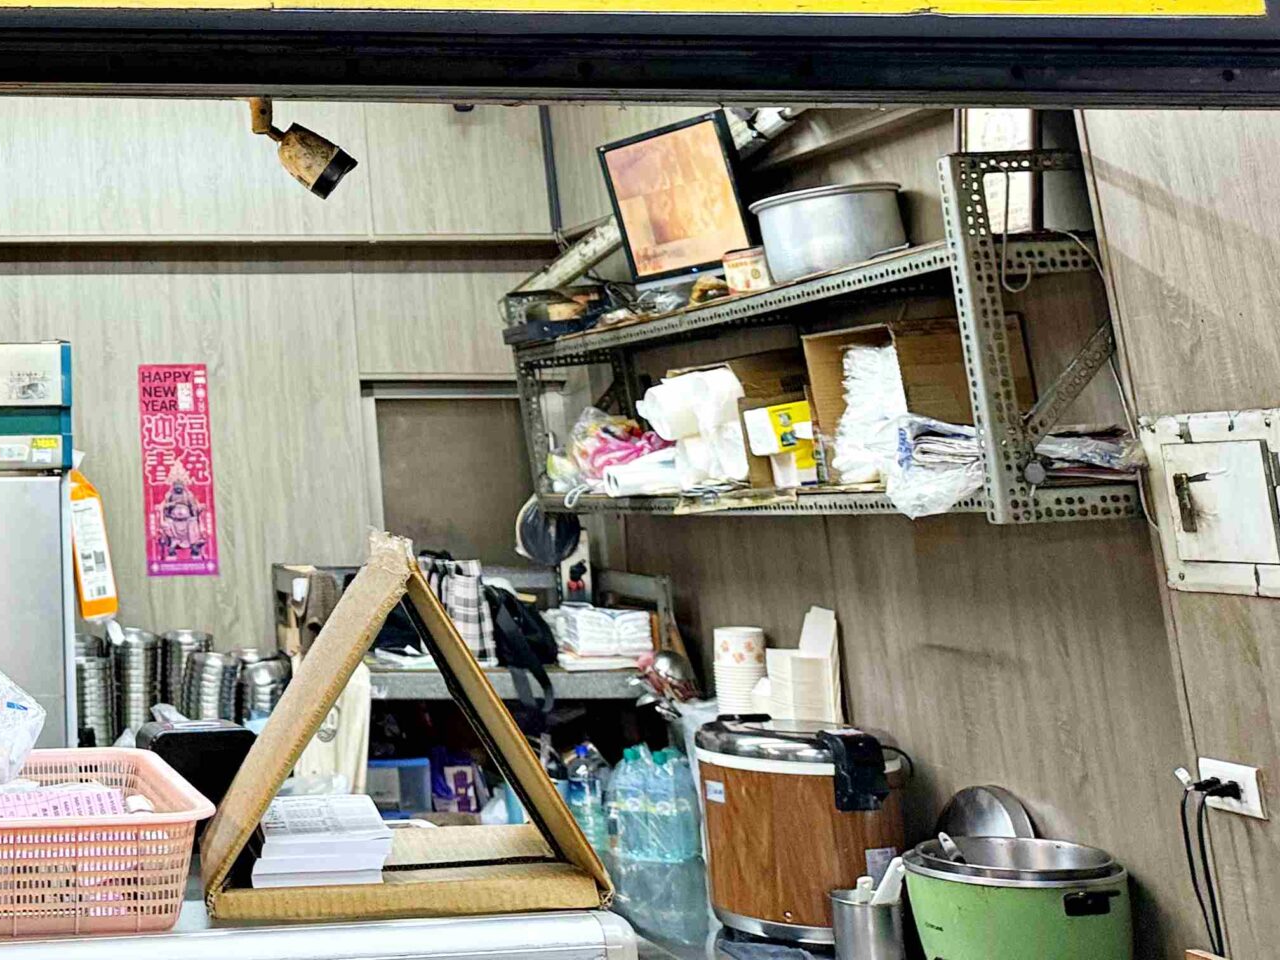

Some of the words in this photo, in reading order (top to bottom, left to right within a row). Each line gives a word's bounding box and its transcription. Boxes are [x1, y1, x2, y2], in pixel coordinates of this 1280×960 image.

[141, 371, 191, 383] HAPPY
[142, 386, 177, 398] NEW
[142, 399, 177, 412] YEAR
